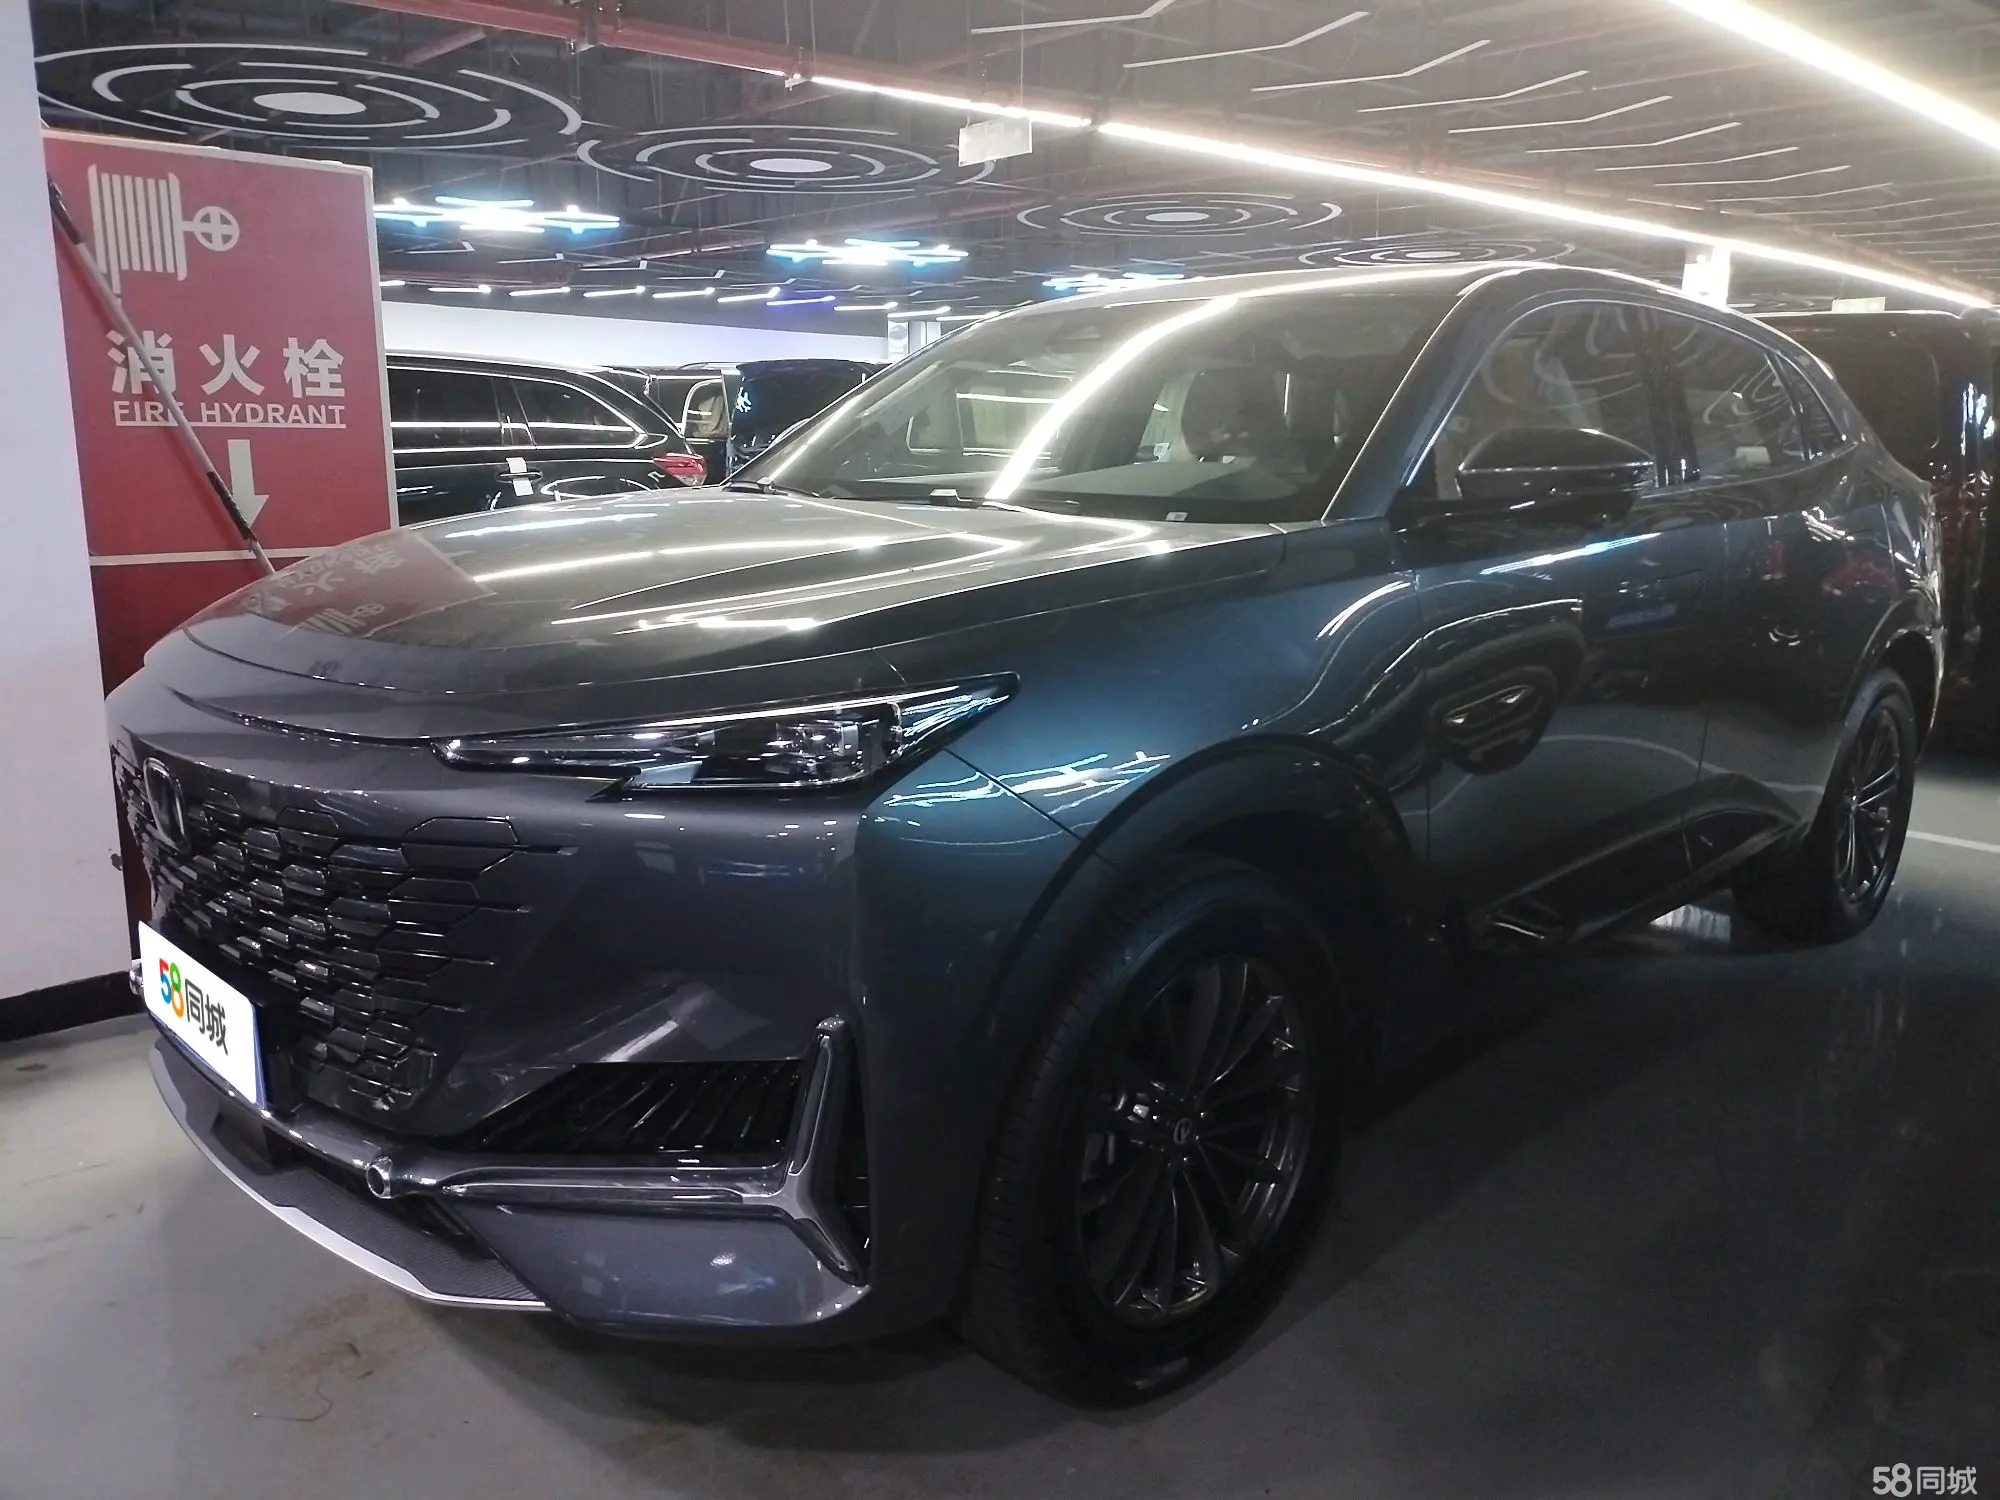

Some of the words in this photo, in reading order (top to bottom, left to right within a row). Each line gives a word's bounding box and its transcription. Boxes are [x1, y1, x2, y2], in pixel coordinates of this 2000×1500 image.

[106, 330, 345, 398] 消火栓
[200, 402, 345, 425] HYDRANT
